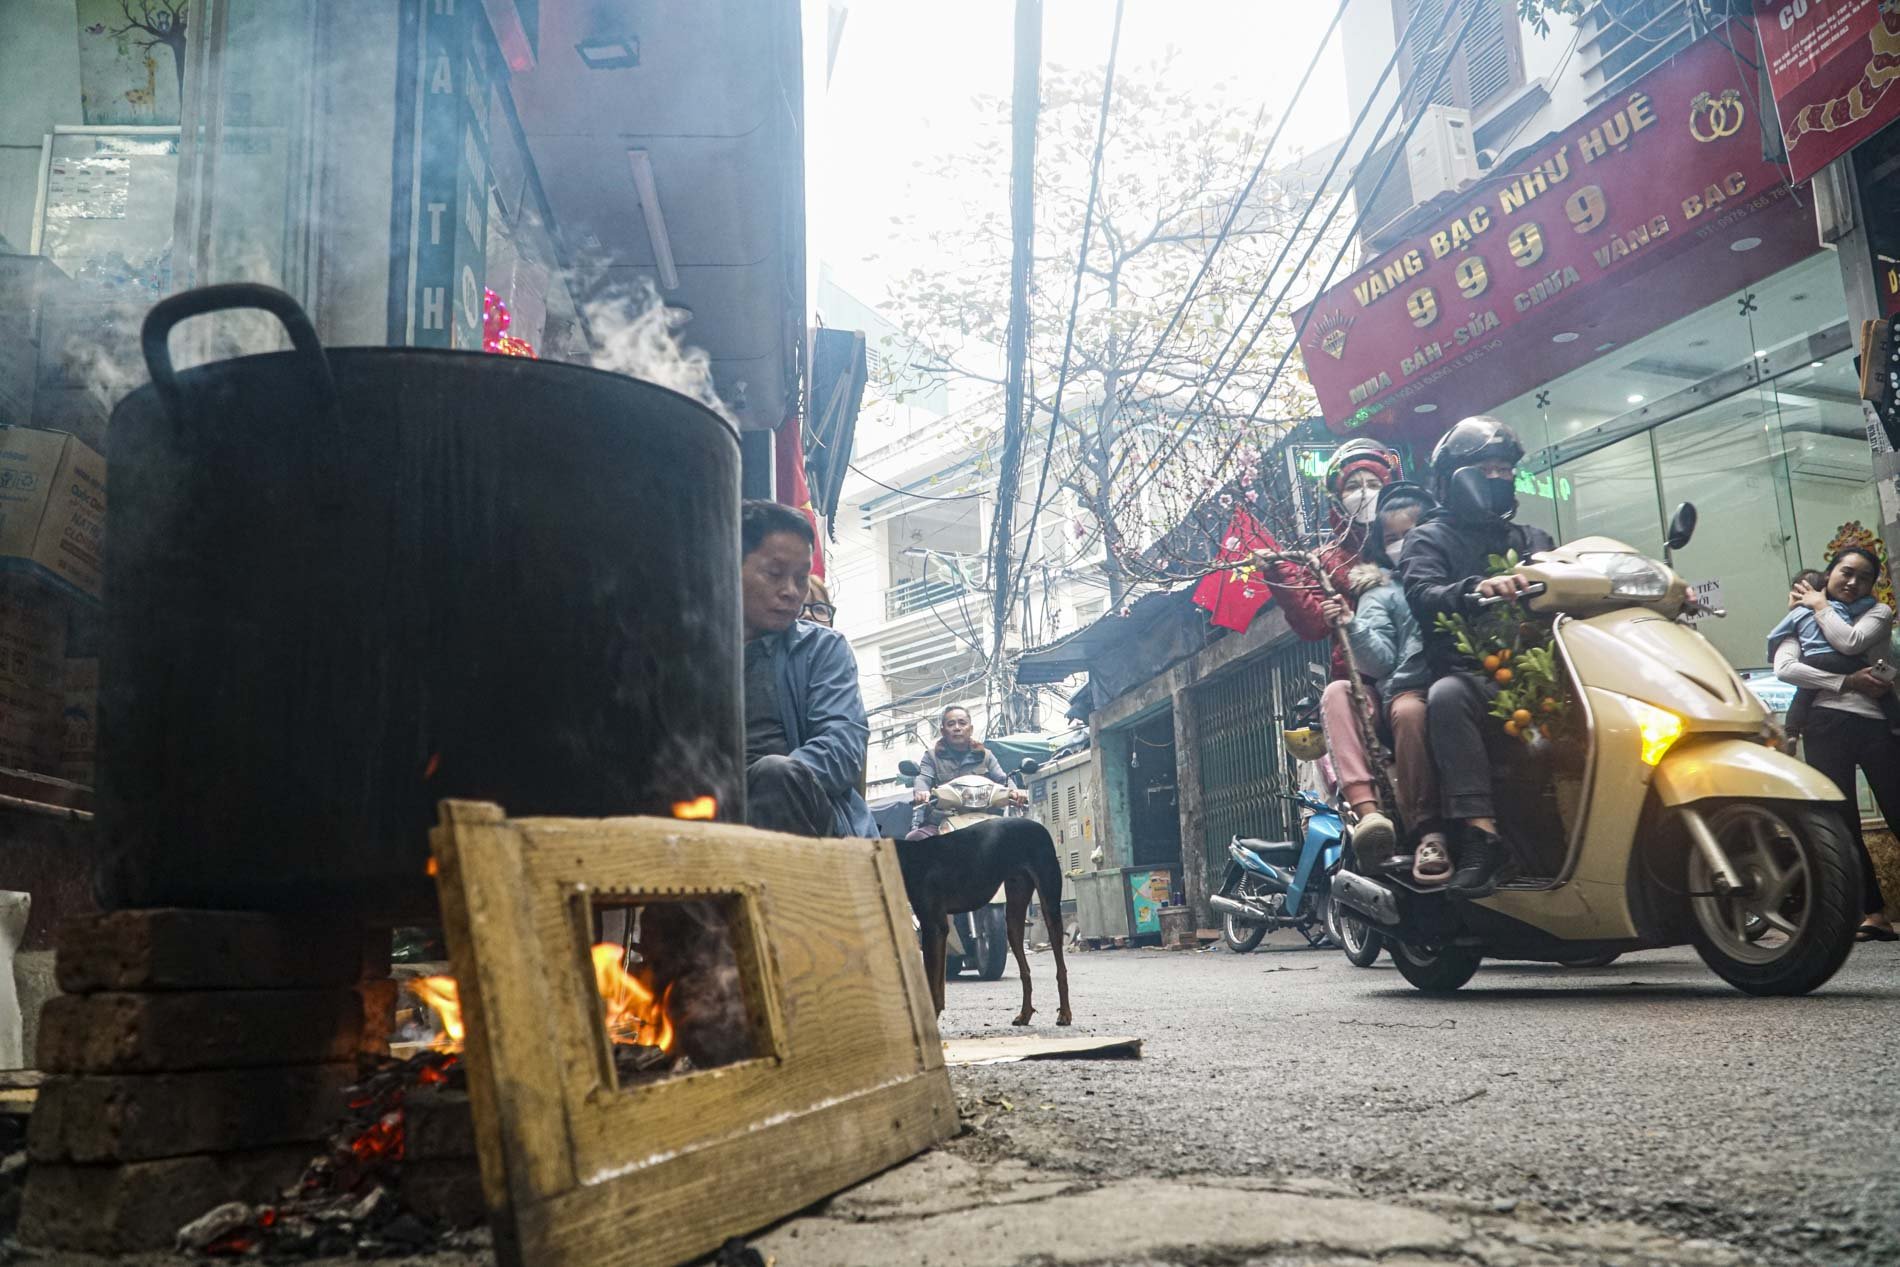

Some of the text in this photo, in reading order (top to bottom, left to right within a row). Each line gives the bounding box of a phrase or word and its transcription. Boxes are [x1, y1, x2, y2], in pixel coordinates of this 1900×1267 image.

[1349, 371, 1392, 405] MUA
[1592, 214, 1670, 268] VÀNG
[1681, 171, 1746, 219] BẠC
[1353, 92, 1657, 308] VÀNG BẠC NHƯ HUỆ
[1406, 185, 1606, 328] 9 9 9 9
